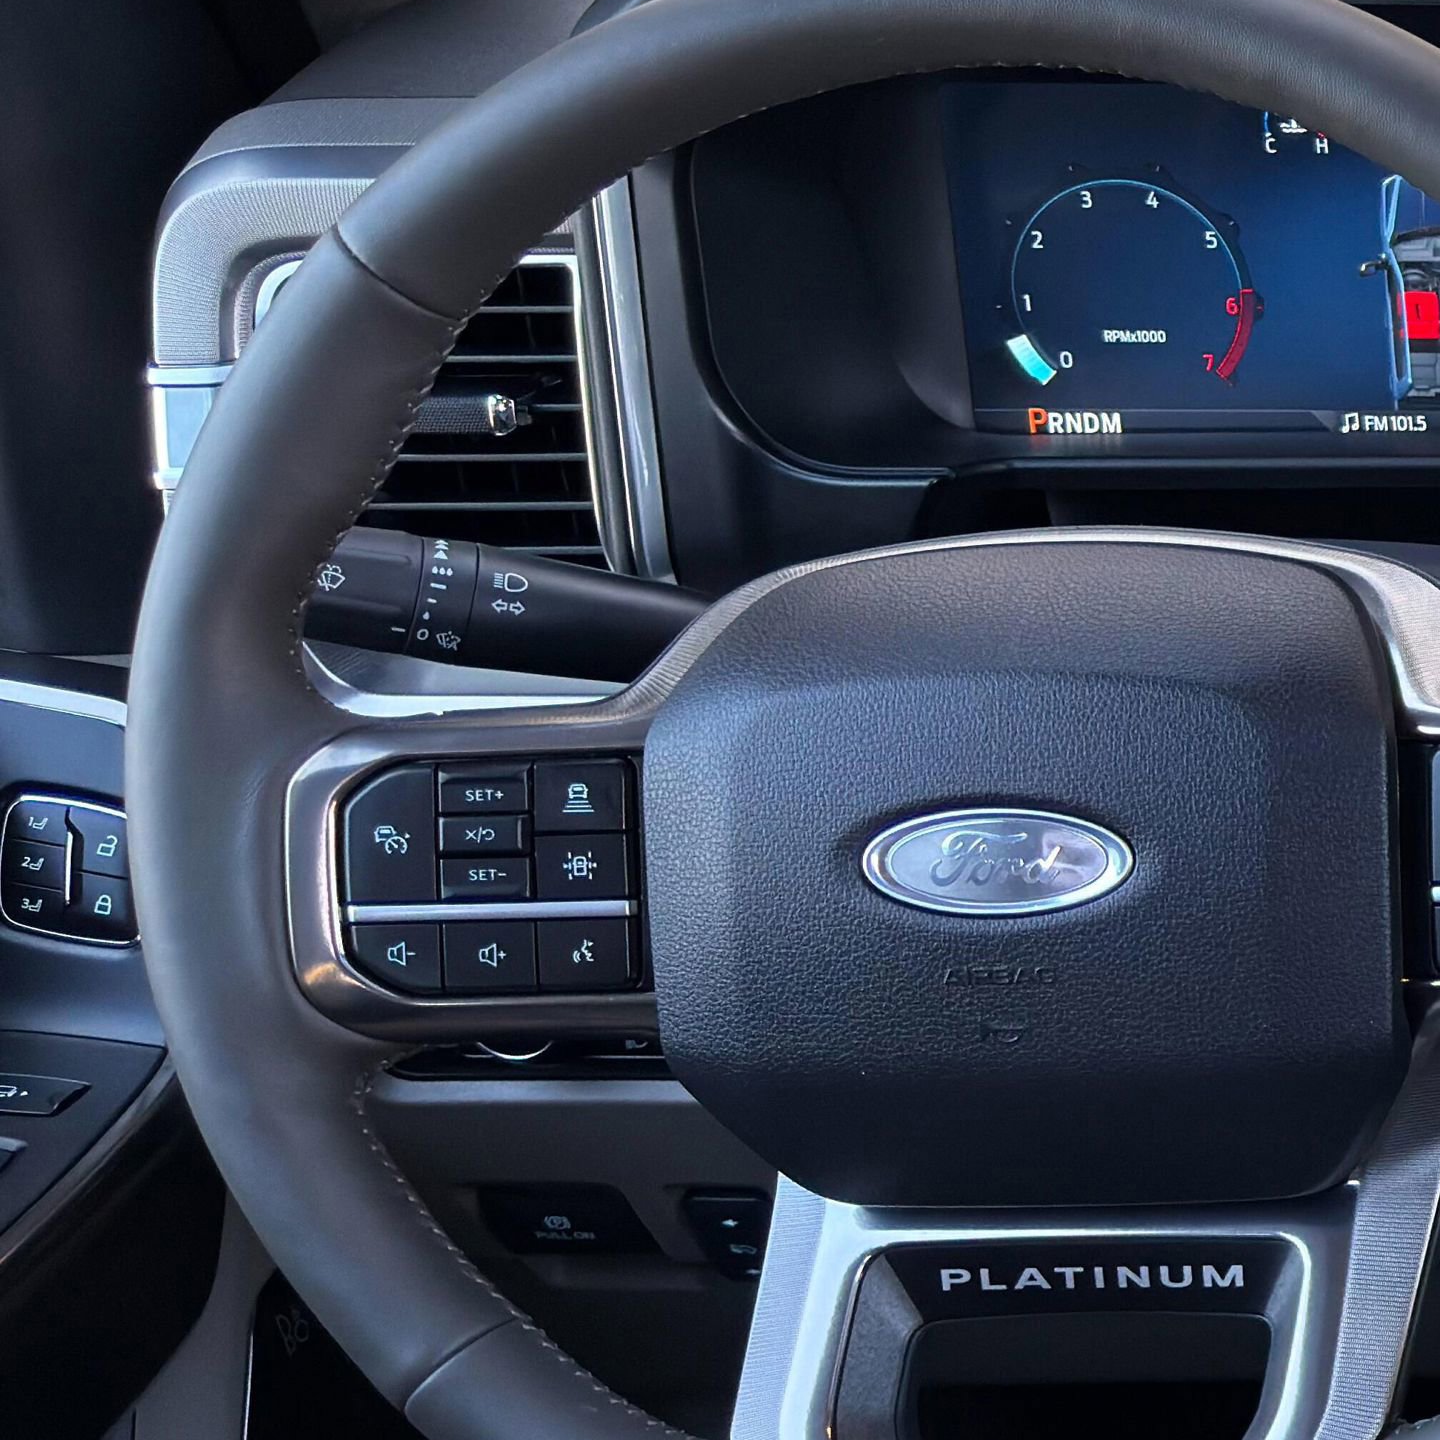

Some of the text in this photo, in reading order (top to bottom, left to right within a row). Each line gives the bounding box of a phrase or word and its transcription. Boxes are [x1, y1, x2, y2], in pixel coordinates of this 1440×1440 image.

[1266, 139, 1277, 154] C
[1316, 139, 1329, 153] H
[1082, 192, 1092, 209] 3
[1145, 192, 1159, 209] 4
[1032, 231, 1043, 249] 2
[1205, 231, 1217, 250] 5
[1023, 294, 1031, 312] 1
[1226, 297, 1238, 315] 6
[1104, 329, 1166, 344] RPMx1000
[1060, 351, 1073, 369] 0
[1203, 354, 1214, 372] 7
[1365, 415, 1426, 432] FM 101.5
[465, 790, 504, 801] SET+
[930, 830, 1062, 887] Ford
[940, 1264, 1244, 1292] PLATINUM
